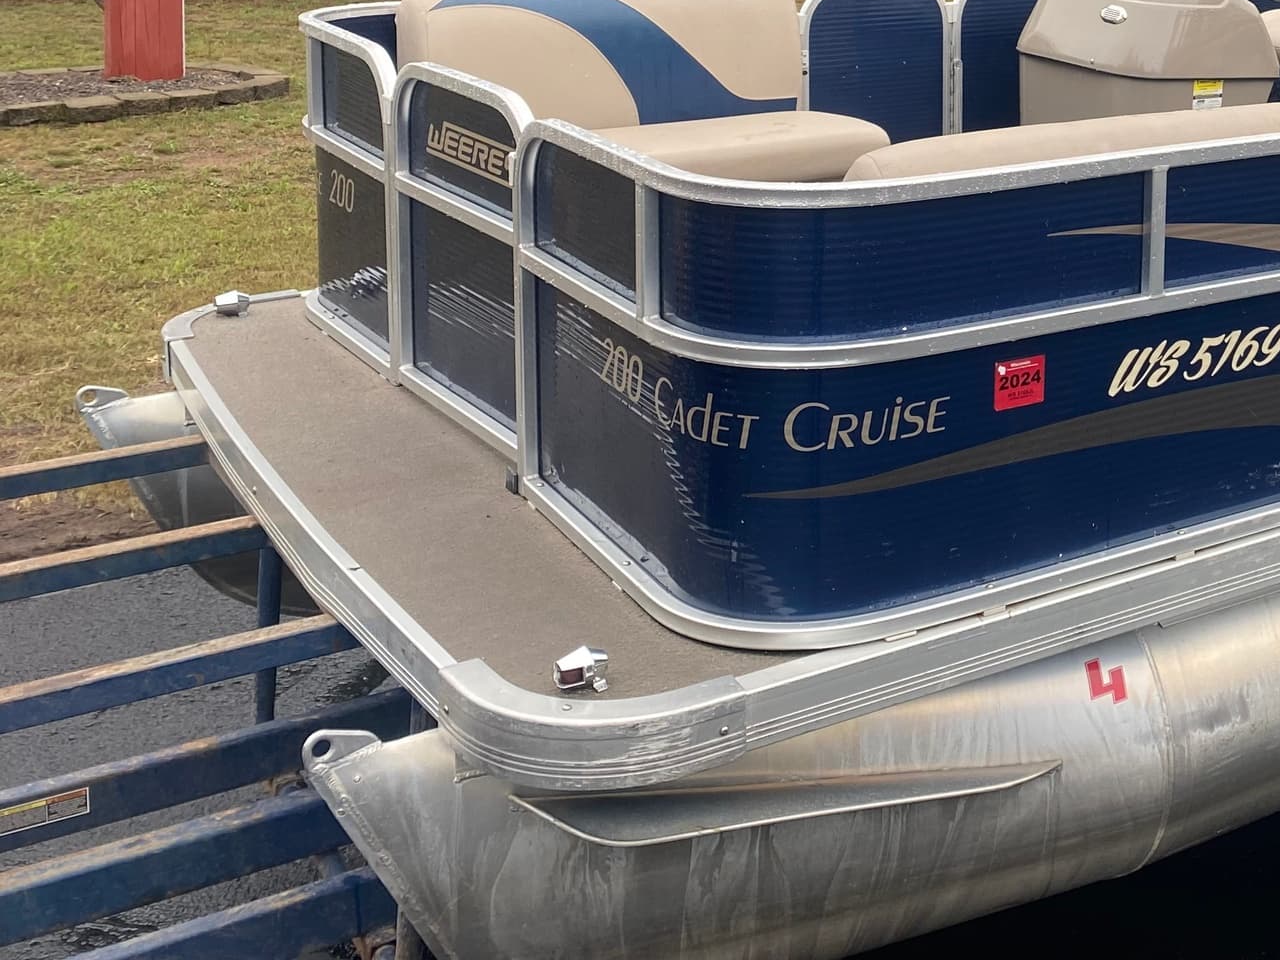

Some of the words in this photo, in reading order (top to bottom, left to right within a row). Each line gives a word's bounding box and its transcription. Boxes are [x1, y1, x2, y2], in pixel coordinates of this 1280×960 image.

[329, 169, 355, 213] 200
[600, 337, 643, 403] 200
[999, 369, 1041, 391] 2024
[1107, 340, 1191, 398] WS
[1084, 657, 1128, 705] 4
